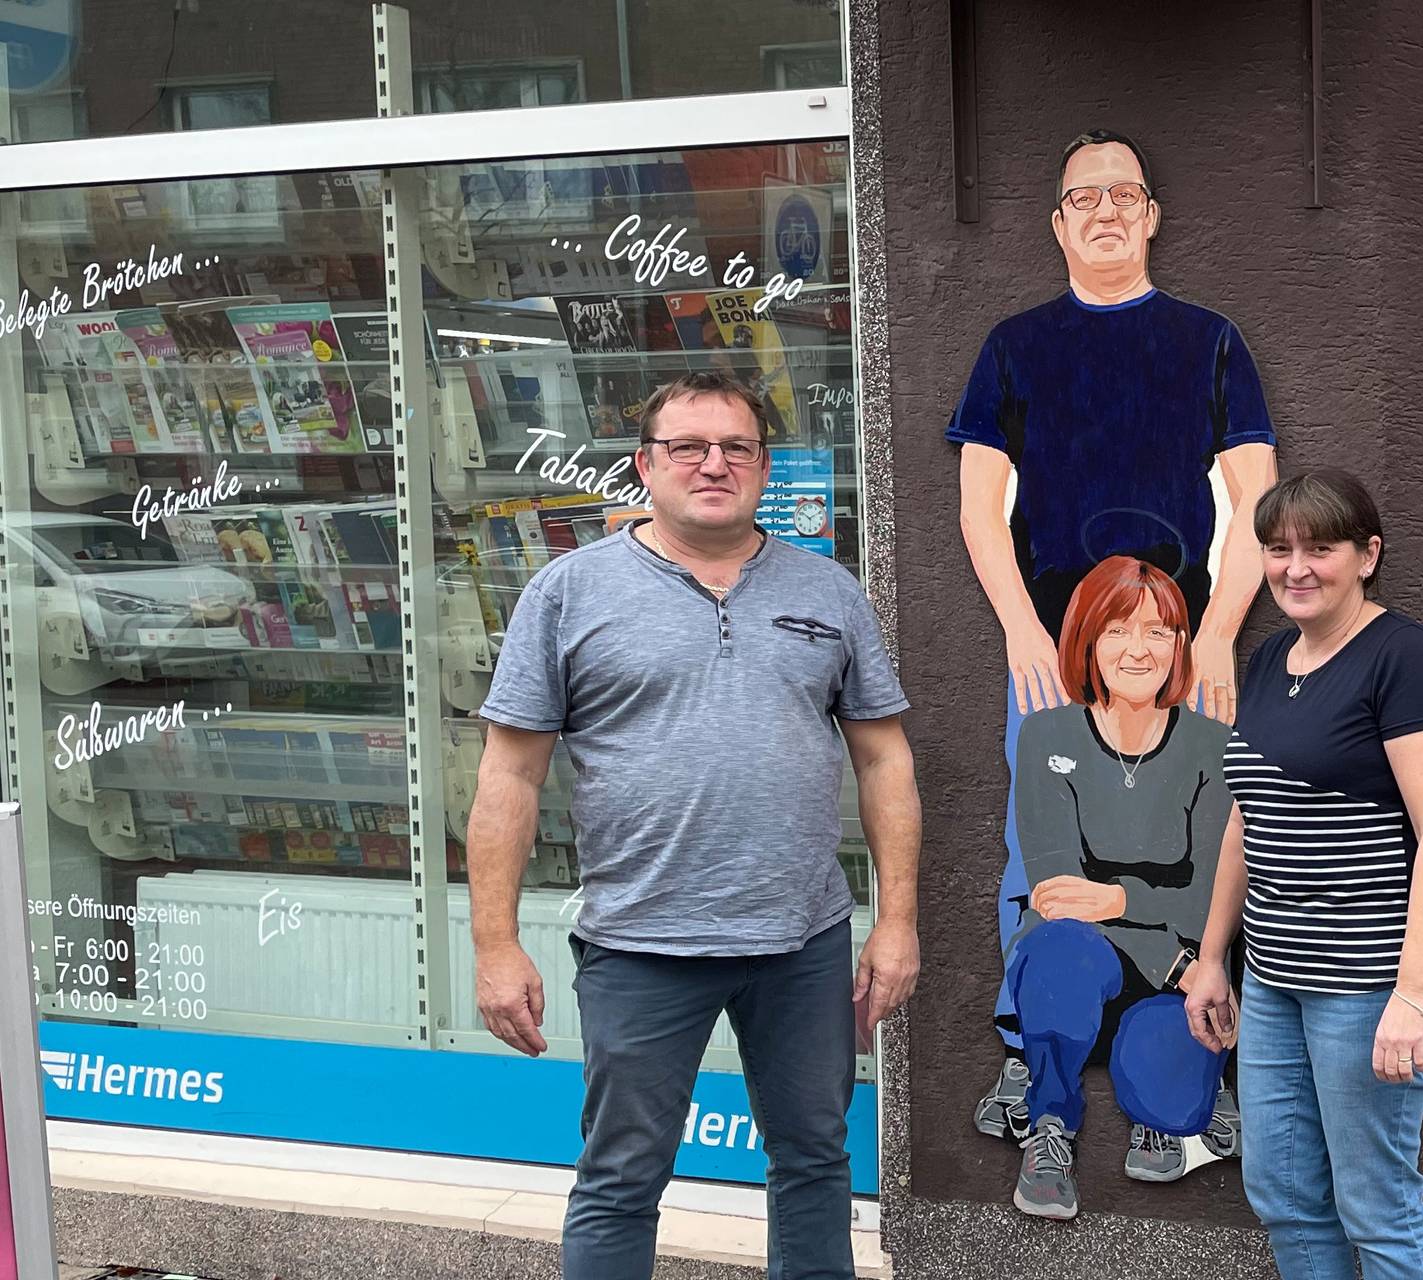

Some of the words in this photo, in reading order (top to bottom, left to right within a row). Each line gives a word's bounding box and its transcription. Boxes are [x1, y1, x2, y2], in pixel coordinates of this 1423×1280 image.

[83, 244, 184, 310] Brötchen
[604, 214, 708, 287] Coffee
[722, 250, 755, 289] to
[754, 272, 804, 314] go
[715, 295, 747, 311] JOE
[132, 460, 243, 541] Getränke
[55, 700, 186, 771] Süßwaren
[68, 893, 201, 926] Öffnungszeiten
[257, 888, 303, 947] Eis
[54, 936, 74, 958] Fr
[86, 938, 129, 962] 6:00
[149, 943, 205, 967] 21:00
[56, 963, 109, 987] 7:00
[135, 968, 206, 993] 21:00
[56, 988, 118, 1013] 10:00
[142, 995, 208, 1020] 21:00
[77, 1053, 225, 1104] Hermes
